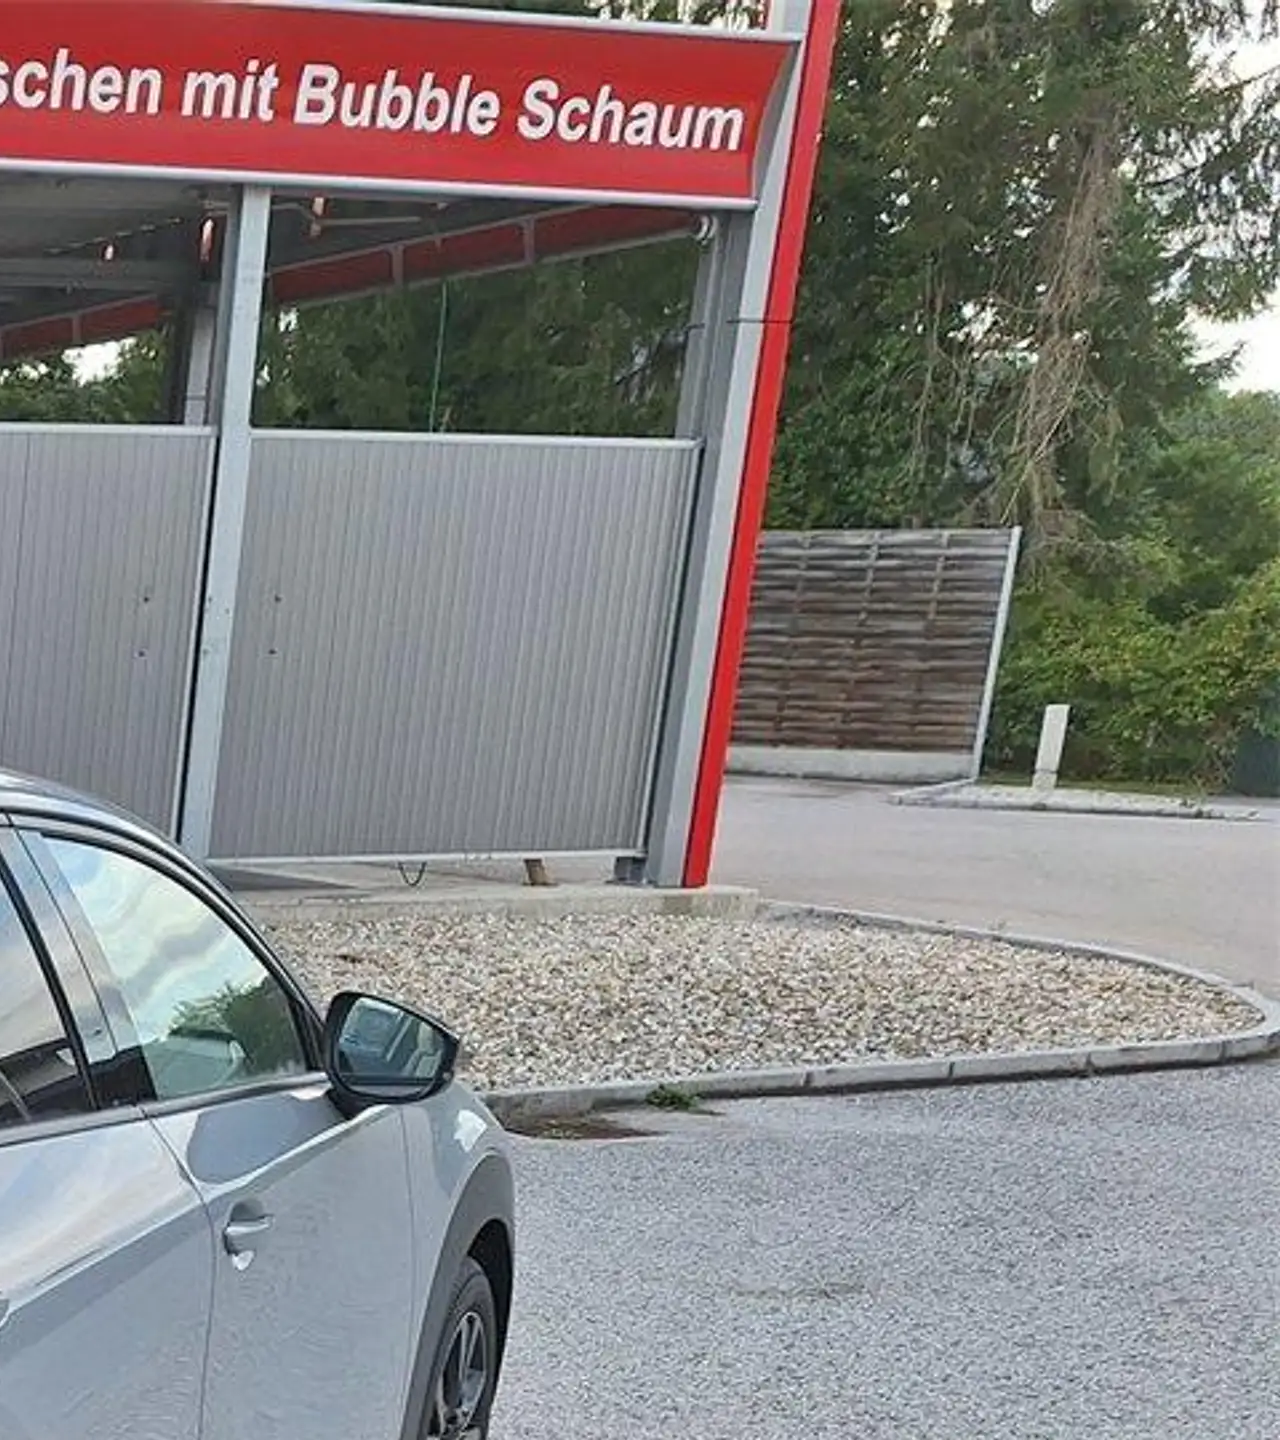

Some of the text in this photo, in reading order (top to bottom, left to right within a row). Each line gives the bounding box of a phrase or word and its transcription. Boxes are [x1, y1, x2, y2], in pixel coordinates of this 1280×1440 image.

[180, 59, 278, 123] mit
[293, 63, 500, 137] Bubble
[516, 78, 744, 152] Schaum
